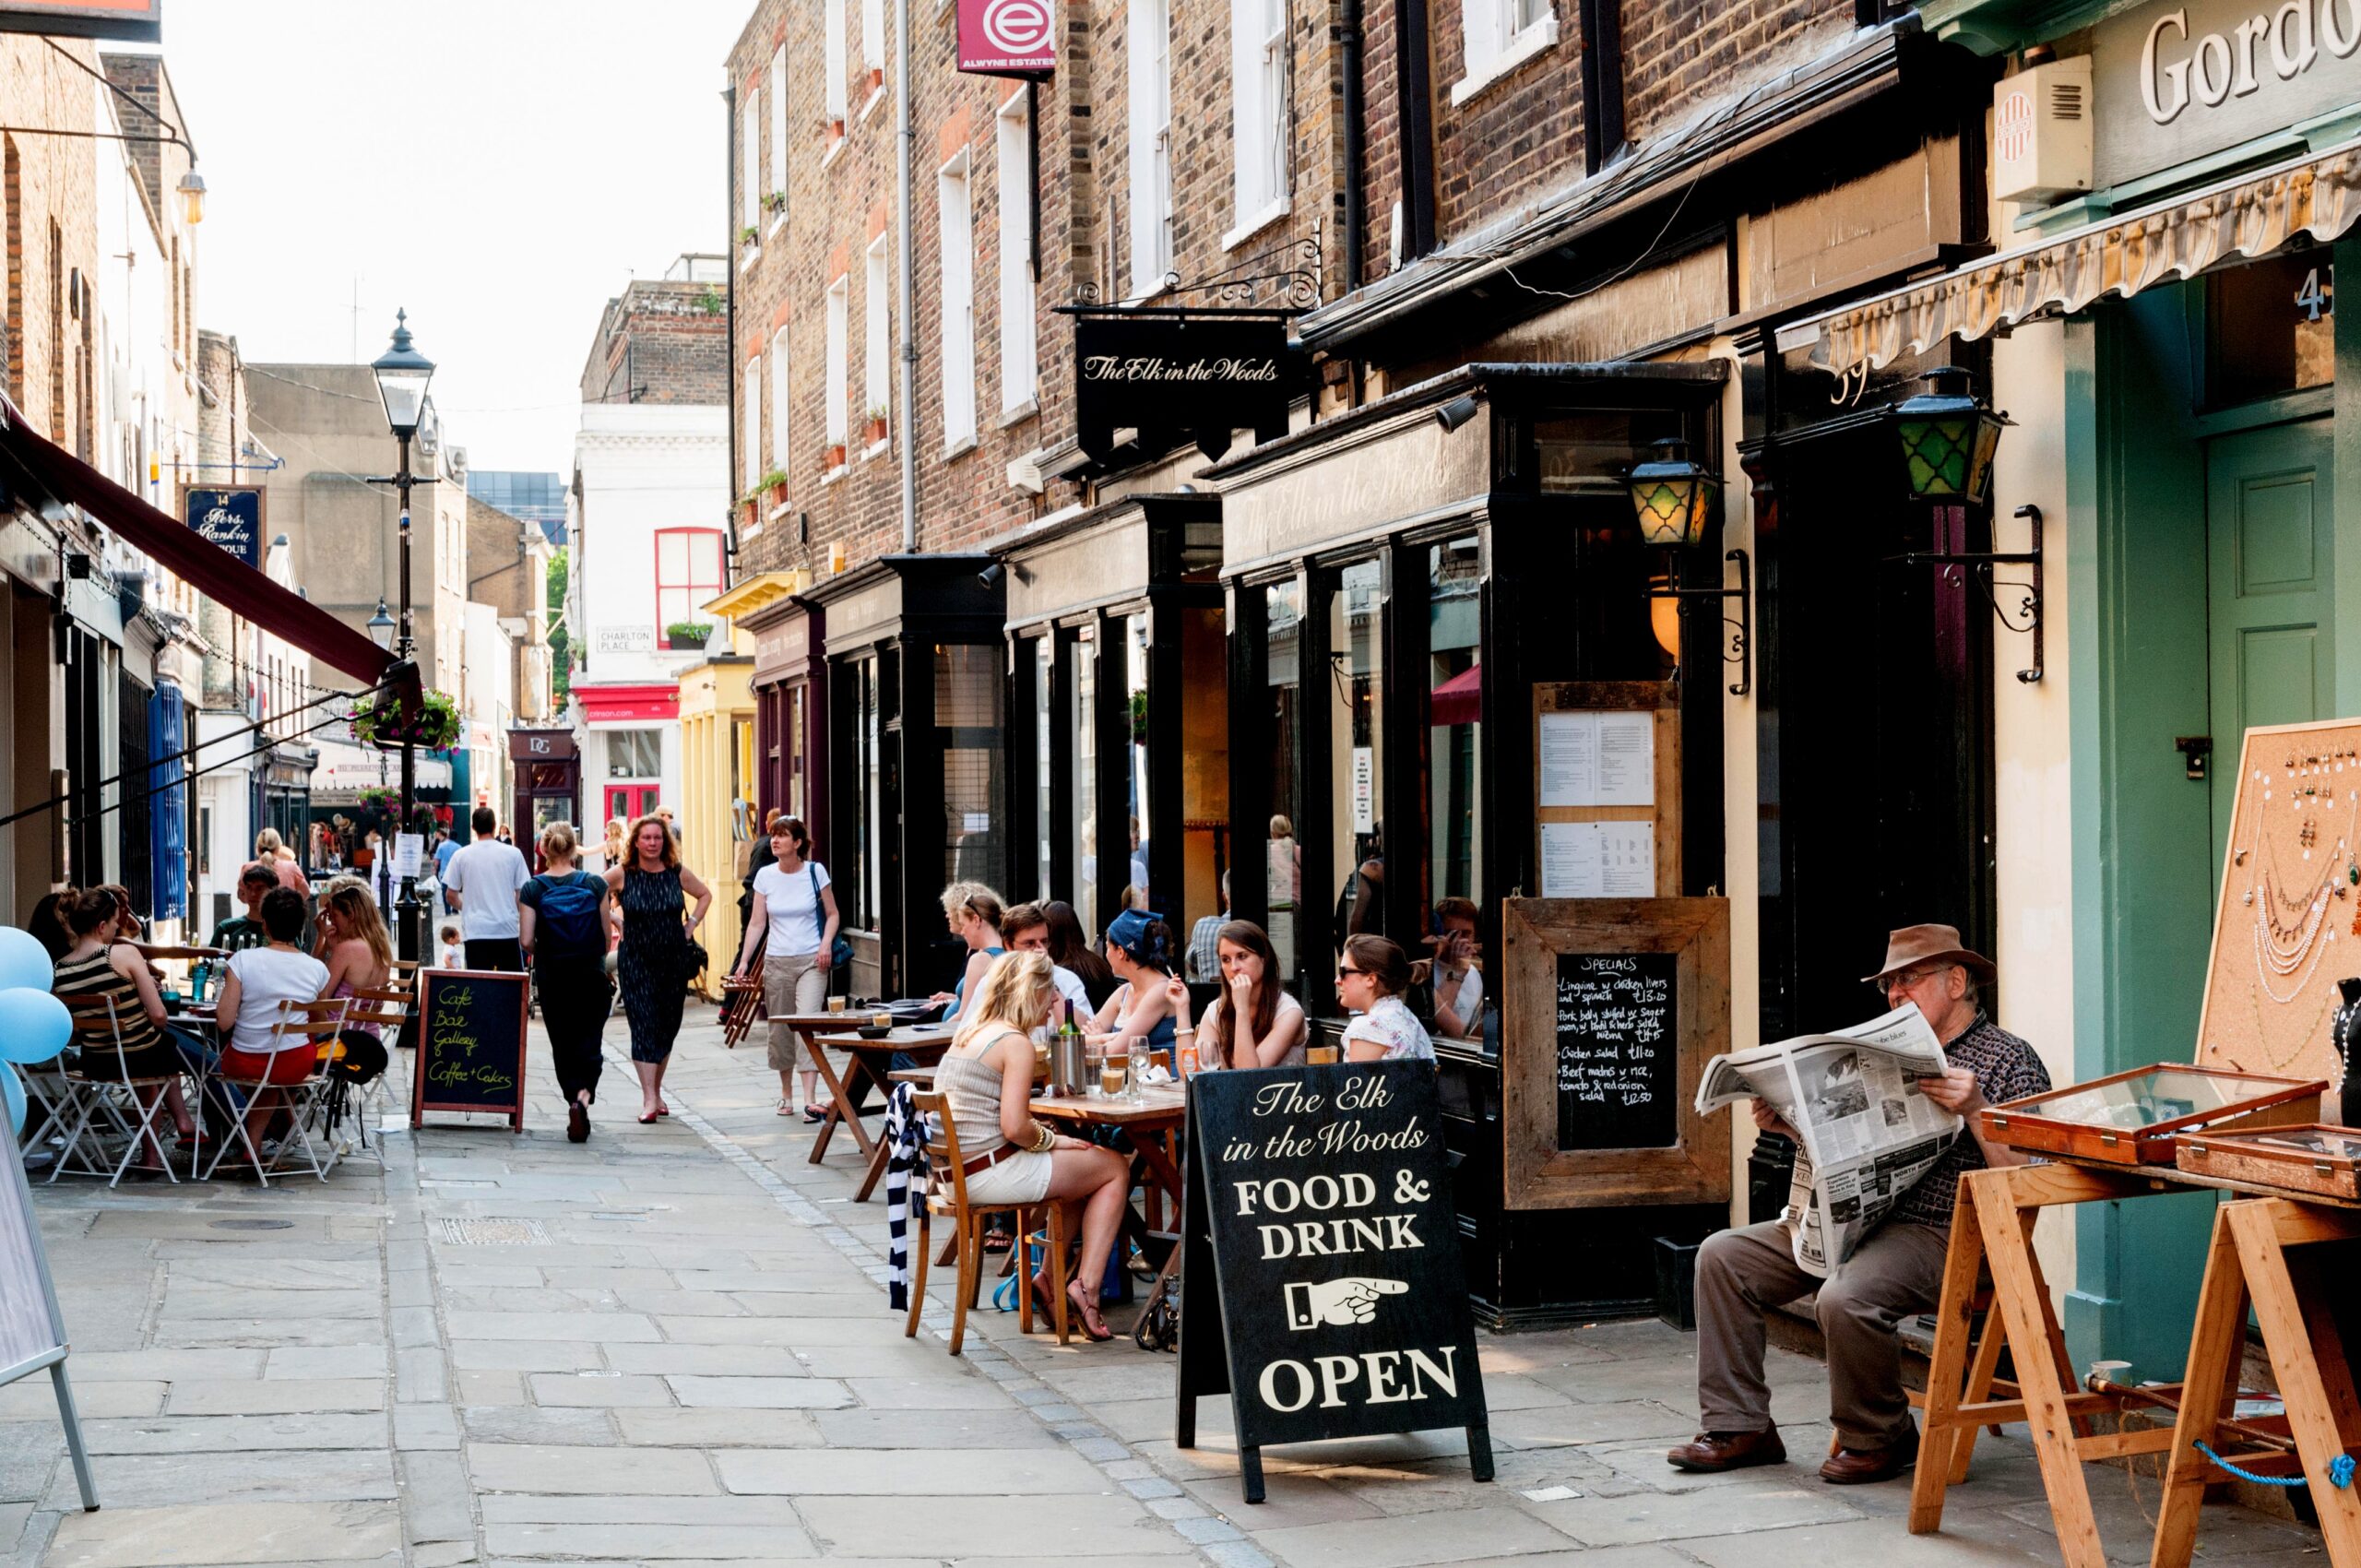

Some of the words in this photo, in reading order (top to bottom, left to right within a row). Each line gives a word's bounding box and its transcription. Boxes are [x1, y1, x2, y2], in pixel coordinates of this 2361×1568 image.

[963, 59, 1008, 67] ALWYNE
[1009, 58, 1055, 66] ESTATES
[1085, 356, 1125, 380] The
[1124, 358, 1166, 383] Elk
[1164, 362, 1186, 380] in
[1185, 358, 1215, 380] the
[1213, 358, 1279, 381] Woods
[1242, 493, 1270, 544] The
[1275, 475, 1310, 535] Elk
[1313, 478, 1335, 524] in
[1340, 459, 1370, 517] the
[1370, 428, 1453, 505] Woods
[218, 494, 229, 506] 14
[196, 523, 252, 542] Rankin
[601, 632, 649, 641] CHARLTON
[601, 641, 630, 649] PLACE
[530, 738, 550, 754] DG
[1581, 957, 1637, 971] SPECIALS
[1614, 980, 1643, 991] chicken
[1559, 993, 1573, 1004] and
[433, 1028, 479, 1057] Gallery
[1560, 1046, 1591, 1060] Chicken
[1595, 1046, 1619, 1059] salad
[429, 1061, 469, 1087] Coffee
[477, 1064, 513, 1091] Cakes
[1561, 1063, 1585, 1079] Beef
[1559, 1080, 1590, 1090] tomato
[1593, 1080, 1603, 1093] &
[1252, 1081, 1325, 1117] The
[1335, 1075, 1394, 1111] Elk
[1579, 1091, 1605, 1102] salad
[1223, 1136, 1260, 1162] in
[1264, 1125, 1318, 1158] the
[1317, 1115, 1430, 1156] Woods
[1893, 1167, 1916, 1179] NORTH
[1233, 1172, 1377, 1217] FOOD
[1393, 1168, 1431, 1205] &
[1257, 1213, 1426, 1261] DRINK
[1258, 1345, 1459, 1413] OPEN
